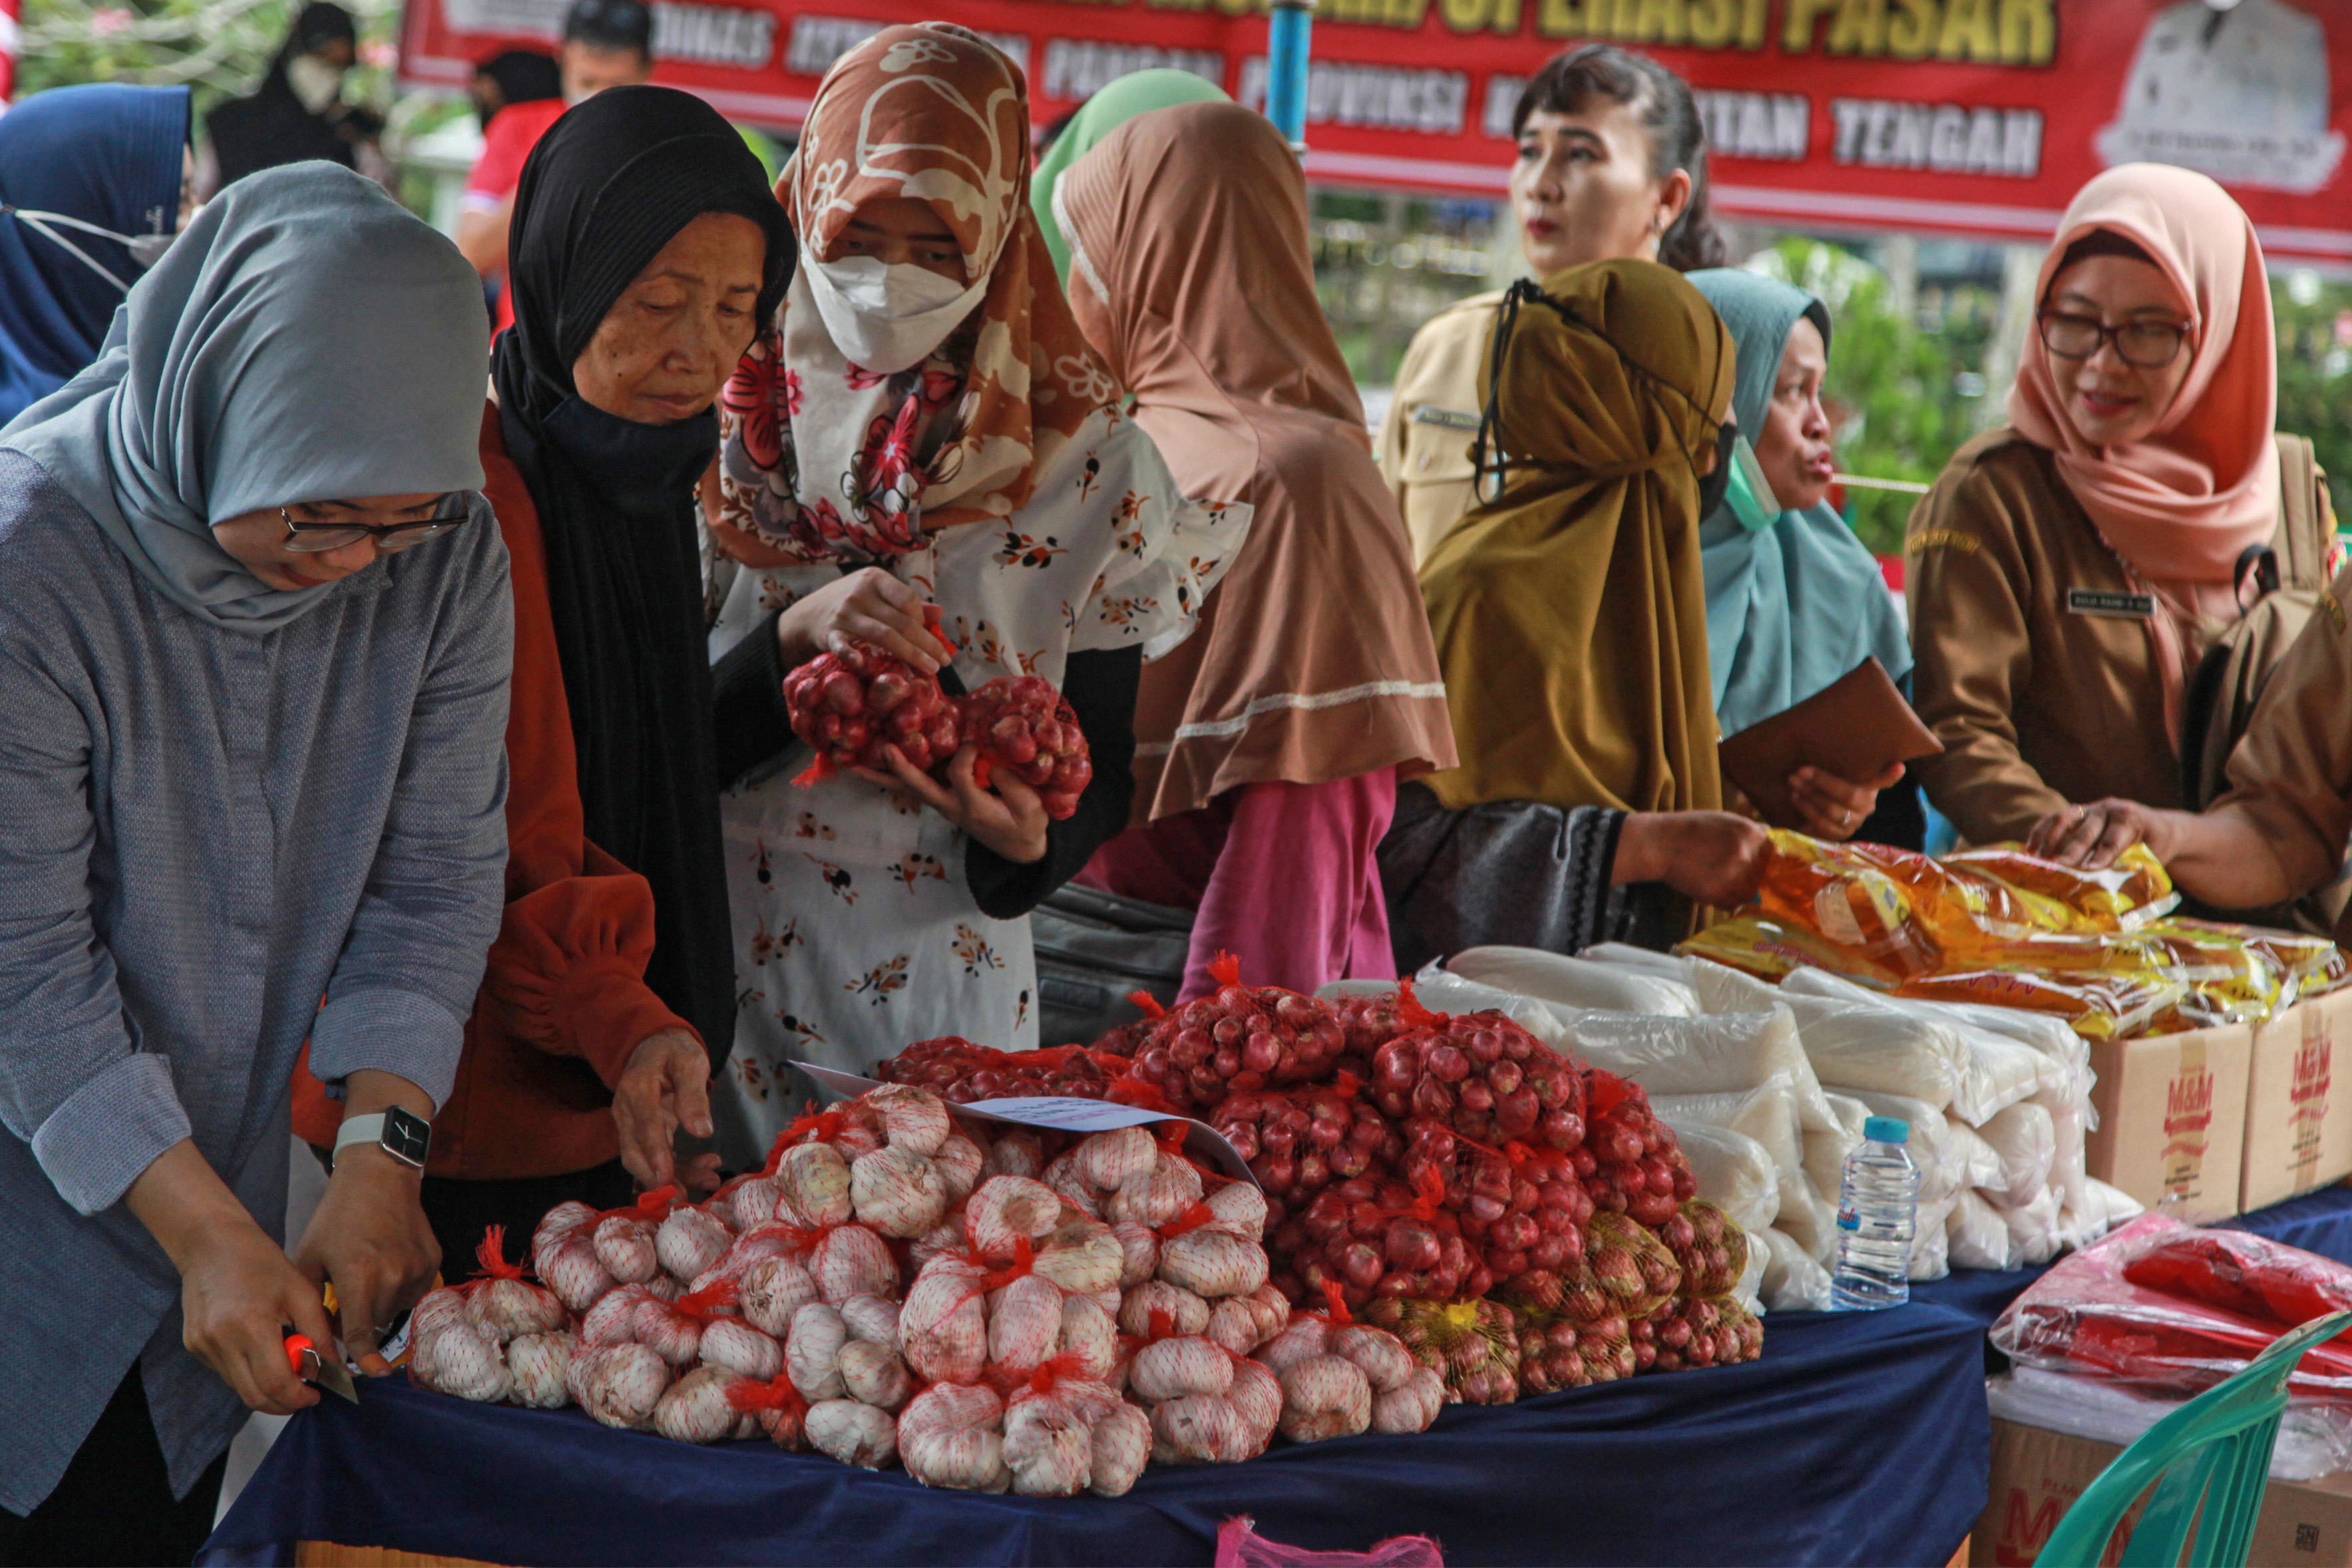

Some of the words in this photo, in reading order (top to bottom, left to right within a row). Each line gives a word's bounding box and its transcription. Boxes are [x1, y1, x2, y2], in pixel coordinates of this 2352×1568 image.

[1781, 0, 2057, 65] PASAR
[1242, 55, 1467, 135] POVINSI
[1833, 97, 2043, 176] TENGAH
[2167, 1073, 2214, 1115] M&M
